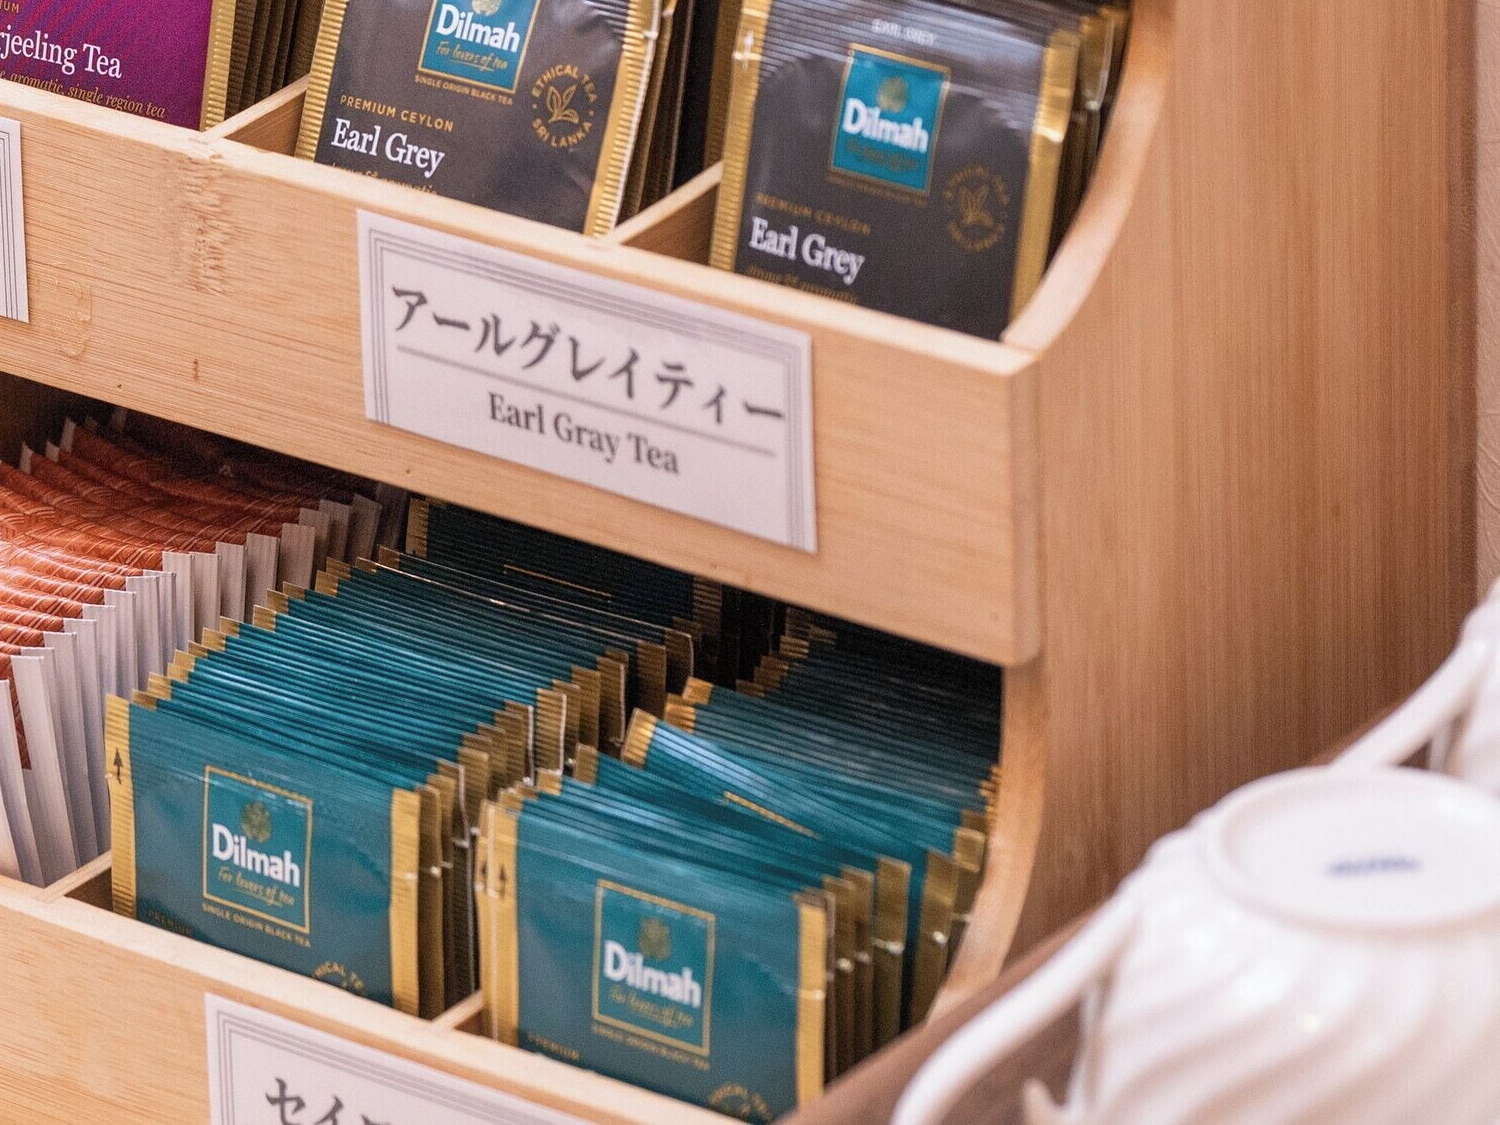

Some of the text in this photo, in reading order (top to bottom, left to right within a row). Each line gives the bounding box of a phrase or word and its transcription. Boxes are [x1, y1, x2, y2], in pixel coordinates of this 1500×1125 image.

[435, 3, 521, 53] Dilmah
[82, 43, 123, 79] Tea
[531, 64, 598, 103] ETHICAL TEA
[67, 83, 103, 105] single
[104, 95, 144, 113] region
[145, 101, 166, 118] tea
[340, 94, 454, 133] PREMIUM CEYLON
[414, 74, 442, 89] SINGLE
[470, 88, 497, 101] BLACK
[498, 95, 514, 106] TEA
[330, 117, 382, 157] Earl
[384, 132, 446, 179] Grey
[550, 120, 593, 148] LANKA
[842, 97, 930, 154] Dilmah
[748, 216, 799, 261] Earl
[801, 232, 866, 286] Grey
[391, 284, 786, 426] アールグレイティー
[488, 391, 680, 475] Earl Gray Tea
[212, 822, 301, 888] Dilmah
[603, 938, 702, 1009] Dilmah
